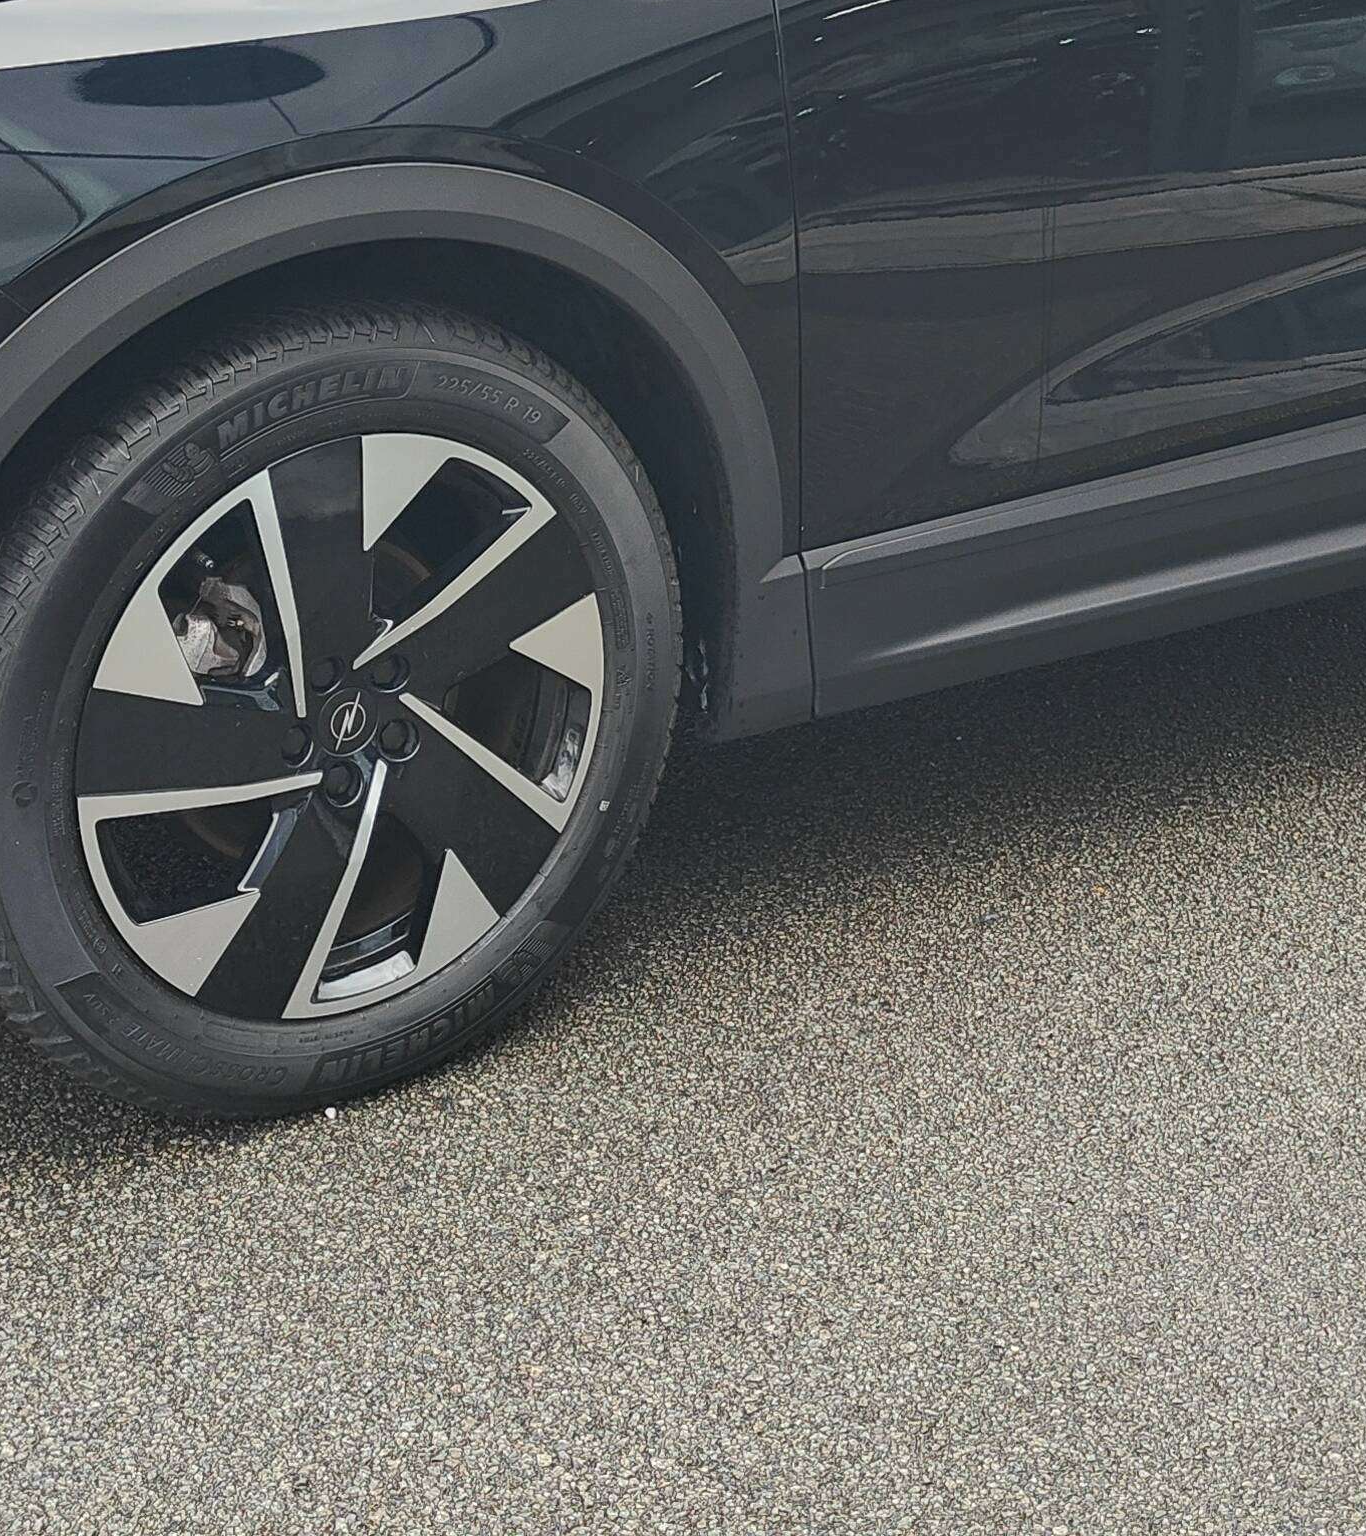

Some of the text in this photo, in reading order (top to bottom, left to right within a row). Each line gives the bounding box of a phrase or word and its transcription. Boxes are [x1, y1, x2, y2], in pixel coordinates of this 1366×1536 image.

[216, 365, 409, 446] MICHELIN
[434, 373, 543, 427] 225/55 R 19
[319, 983, 497, 1085] MICHELIN
